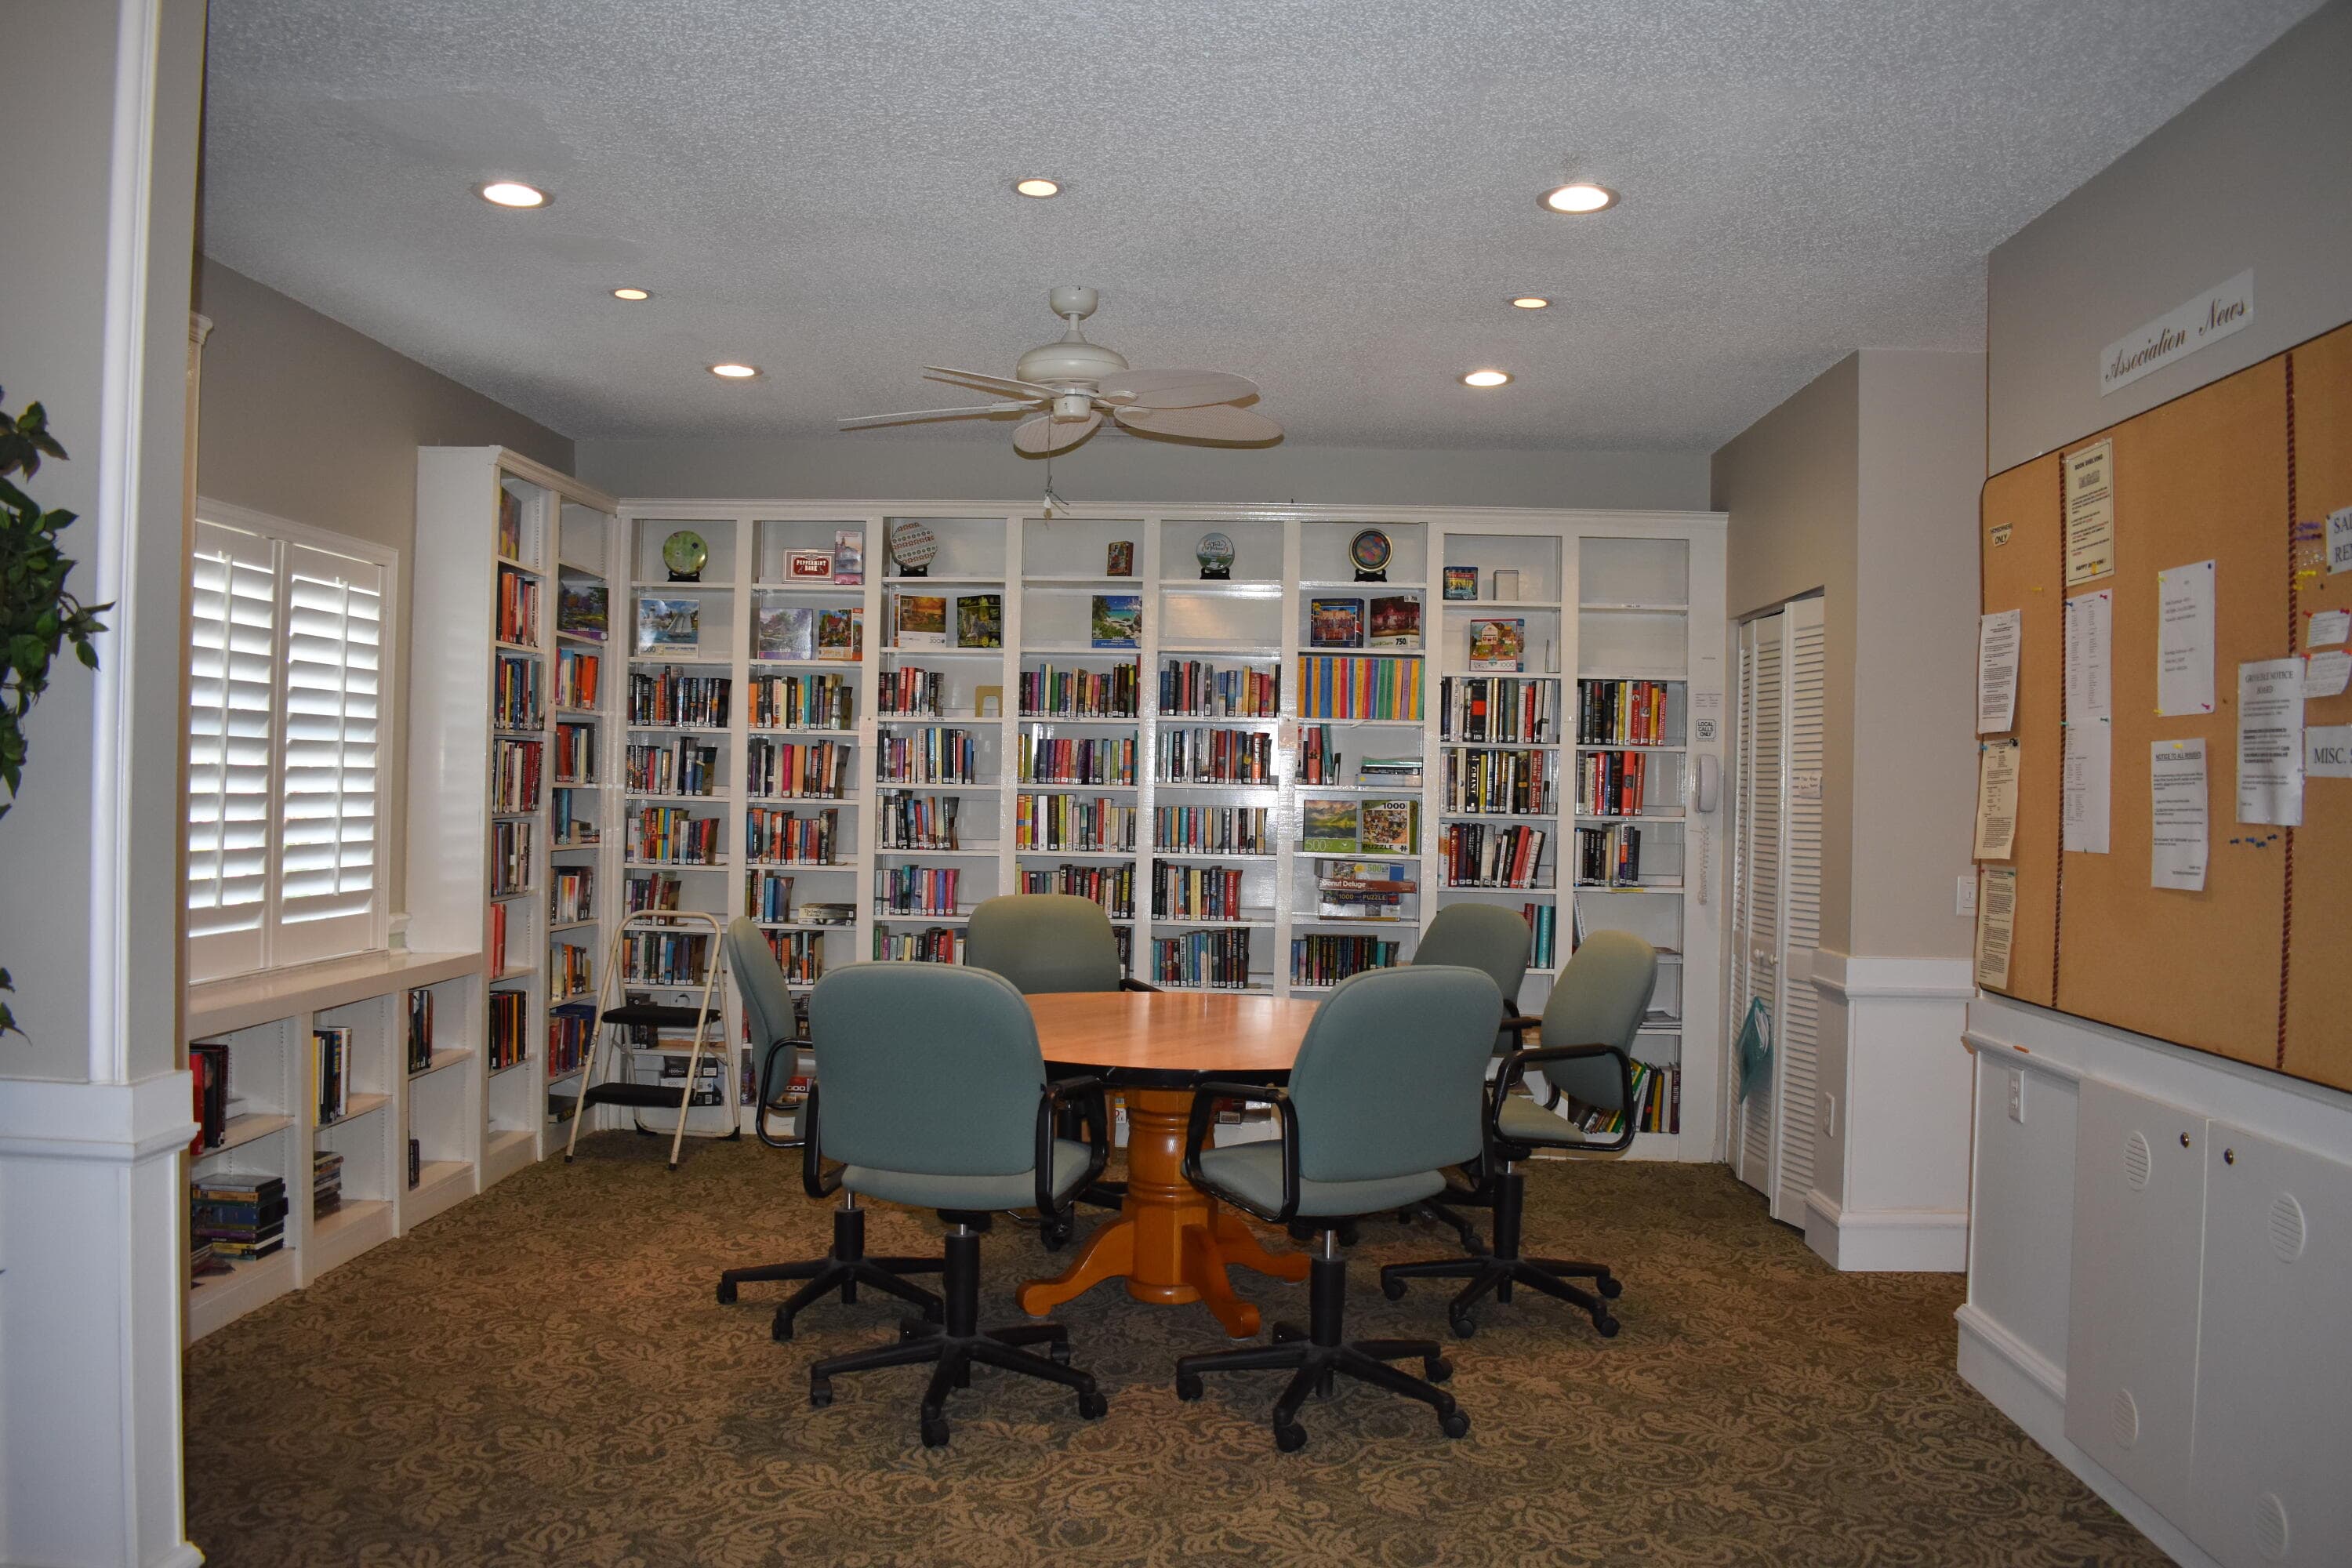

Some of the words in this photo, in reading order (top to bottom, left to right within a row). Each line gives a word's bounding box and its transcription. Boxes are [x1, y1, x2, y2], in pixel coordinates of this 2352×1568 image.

[2104, 328, 2187, 383] Association
[2198, 297, 2245, 336] News
[1994, 533, 2008, 545] ONLY
[2335, 543, 2352, 563] RE
[2314, 746, 2347, 764] MISC.
[1305, 839, 1327, 851] 500
[1367, 864, 1382, 873] 500
